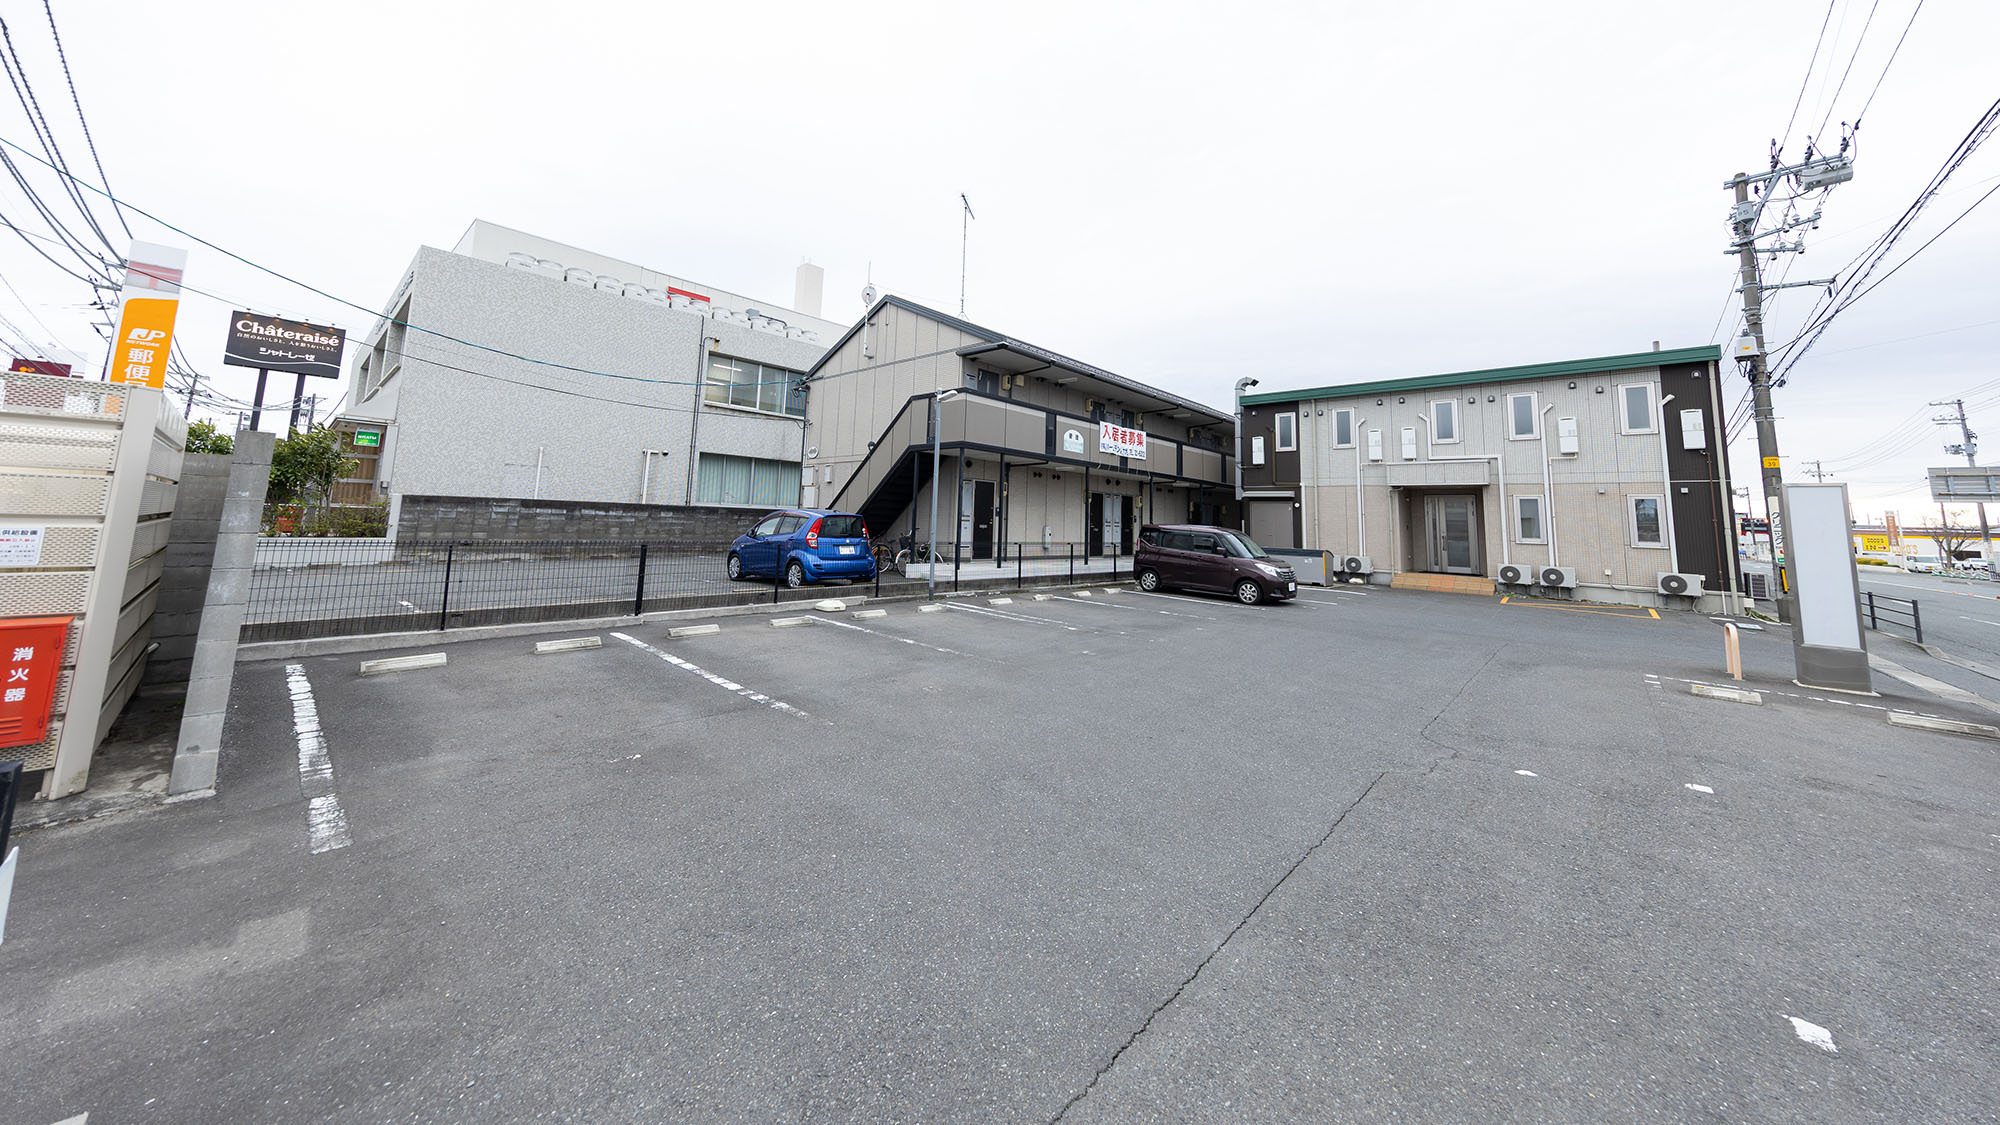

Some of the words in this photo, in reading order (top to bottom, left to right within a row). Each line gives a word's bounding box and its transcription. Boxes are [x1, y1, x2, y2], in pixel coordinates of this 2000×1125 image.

[236, 320, 340, 347] Châteraisé
[259, 347, 316, 362] シャトレーゼ
[1102, 424, 1145, 448] 入居者募集
[4, 646, 35, 703] 消火器
